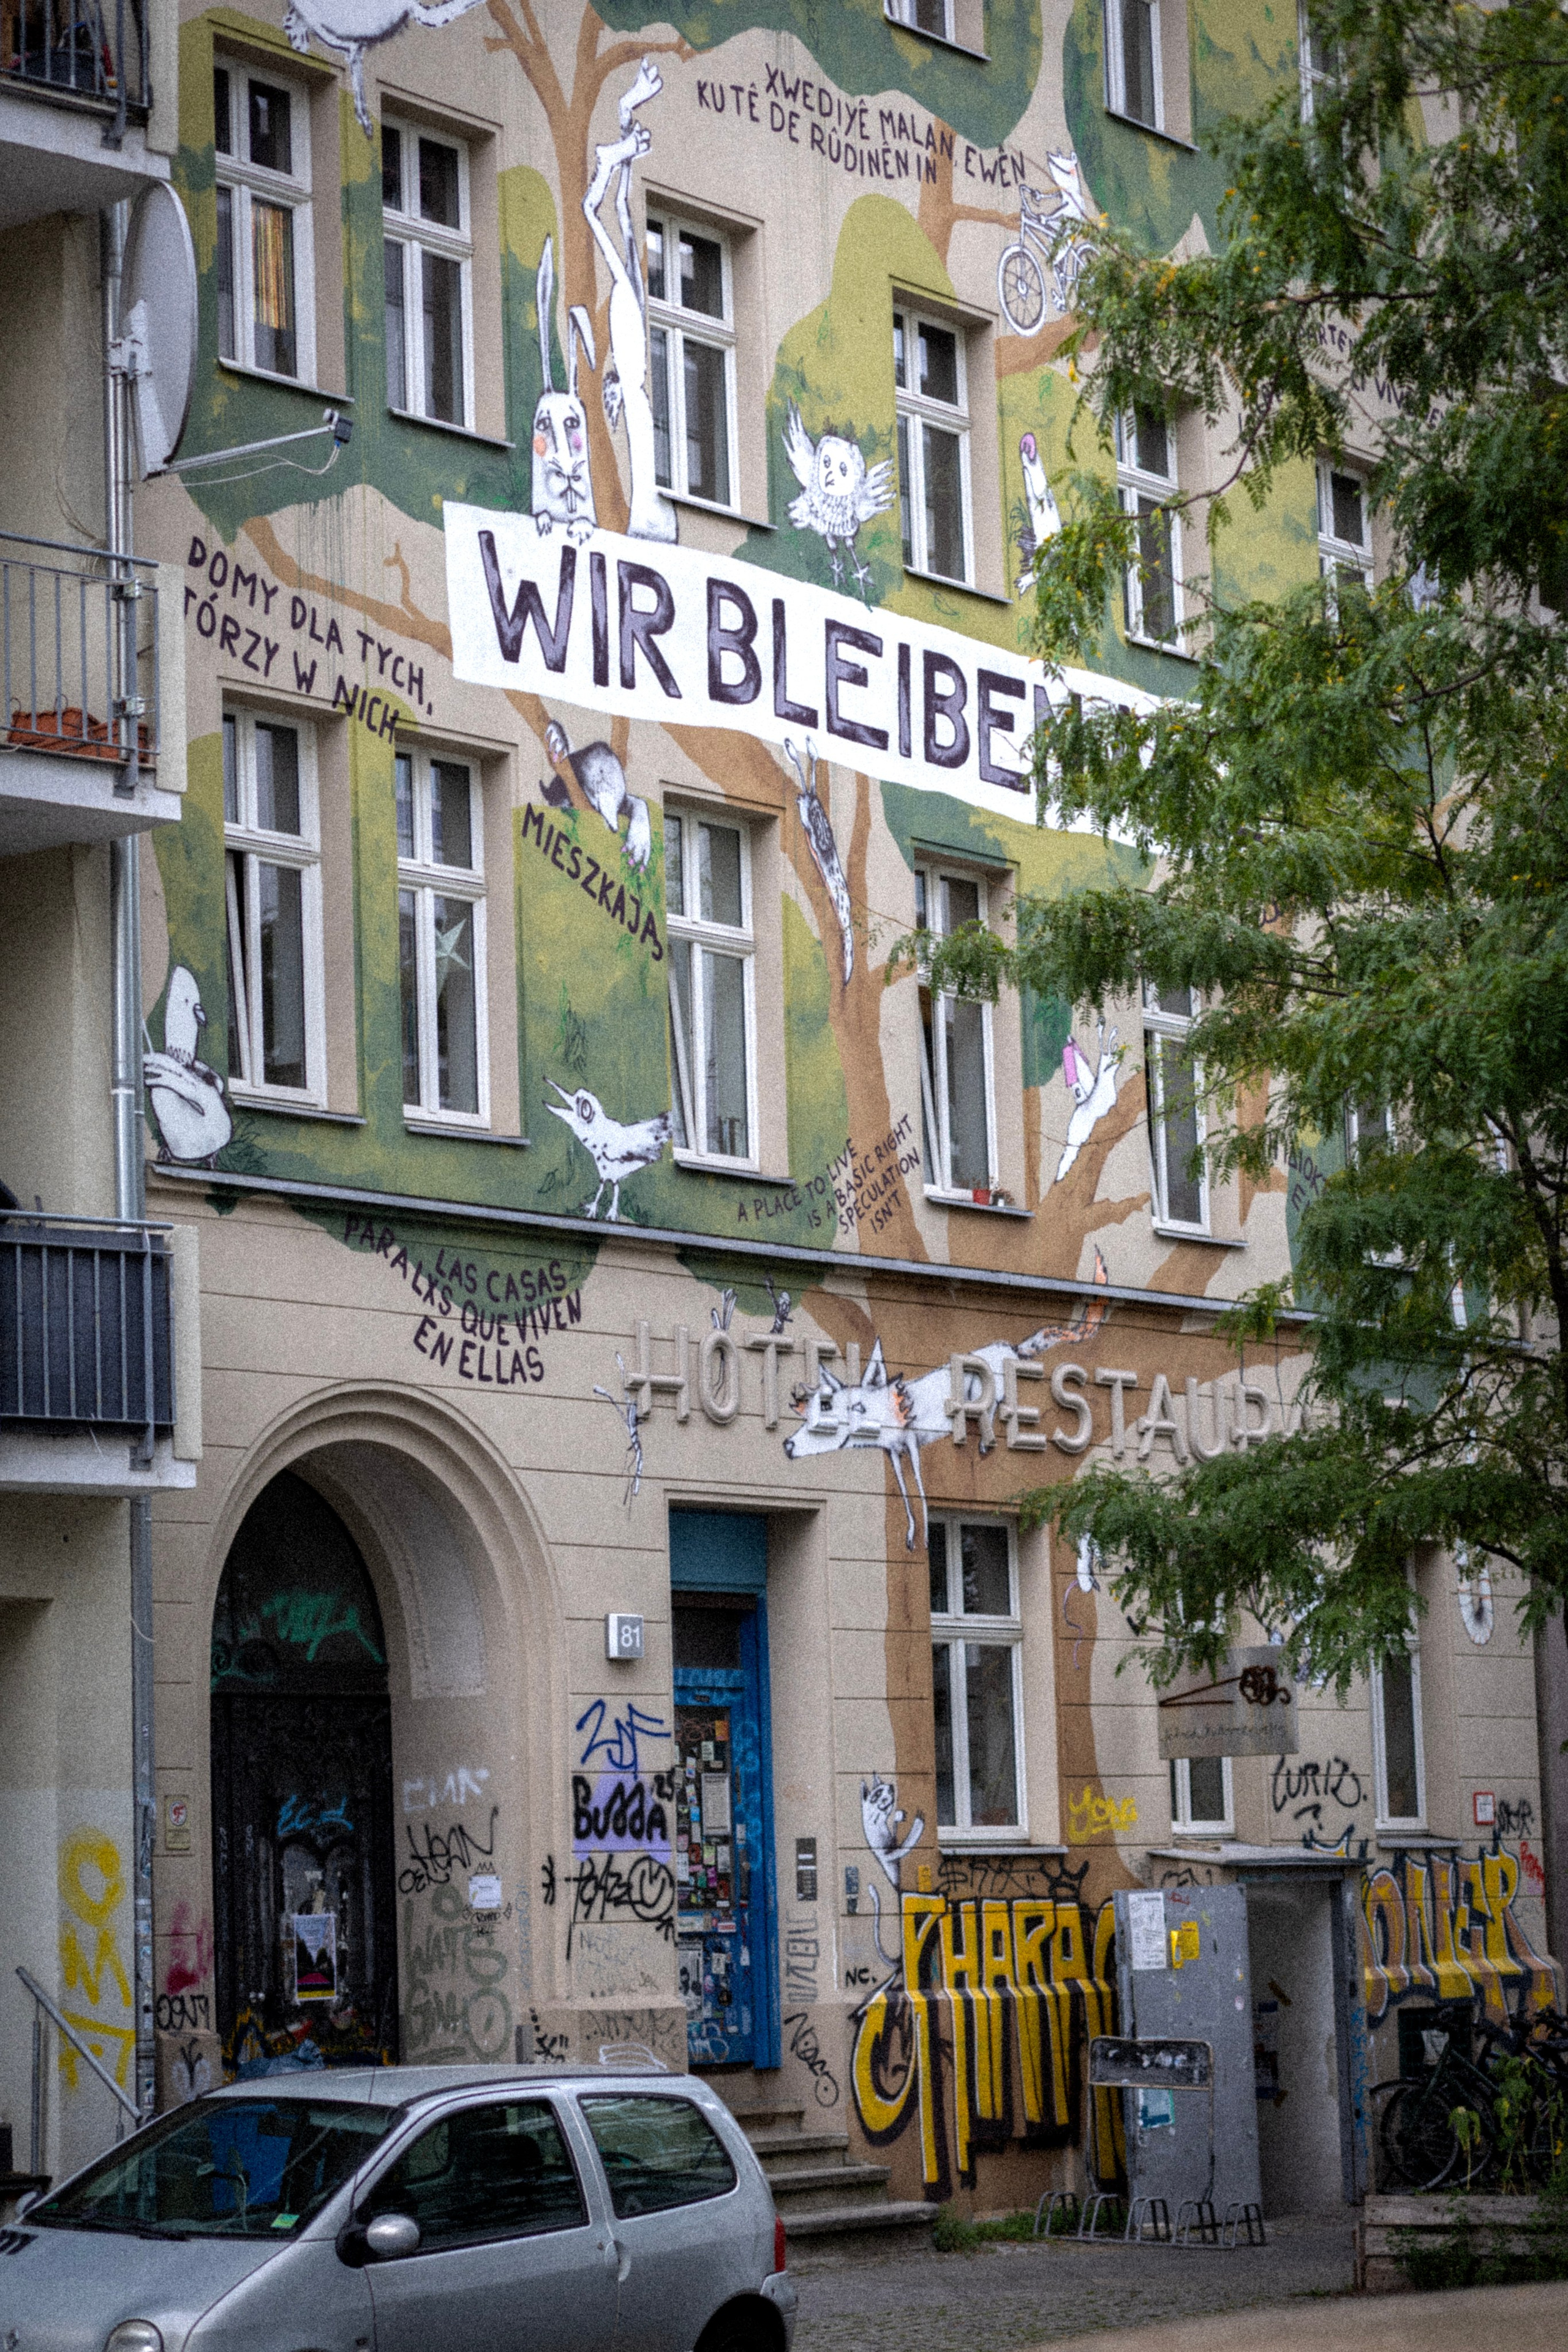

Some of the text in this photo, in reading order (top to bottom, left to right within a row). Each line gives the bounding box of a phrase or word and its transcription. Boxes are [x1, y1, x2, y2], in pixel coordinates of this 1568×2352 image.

[766, 63, 869, 140] XWEDIYÊ
[965, 145, 1025, 187] EWÊN
[769, 101, 799, 143] DE
[919, 153, 937, 184] IN
[187, 535, 279, 615] DOMY
[290, 595, 344, 654] DLA
[478, 529, 682, 699] WIR
[184, 585, 399, 745] TÓRZY W NICH
[737, 1138, 858, 1223] A PLACE TO LIVE
[807, 1114, 913, 1229] IS A BASIC RIGHT
[838, 1147, 921, 1235] SPECULATION
[870, 1190, 902, 1234] ISN'T
[343, 1215, 582, 1346] PARA LXS QUE VIVEN
[435, 1248, 567, 1303] LAS CASAS
[413, 1315, 545, 1385] EN ELLAS
[626, 1319, 882, 1439] HOTEL
[620, 1624, 641, 1648] 81
